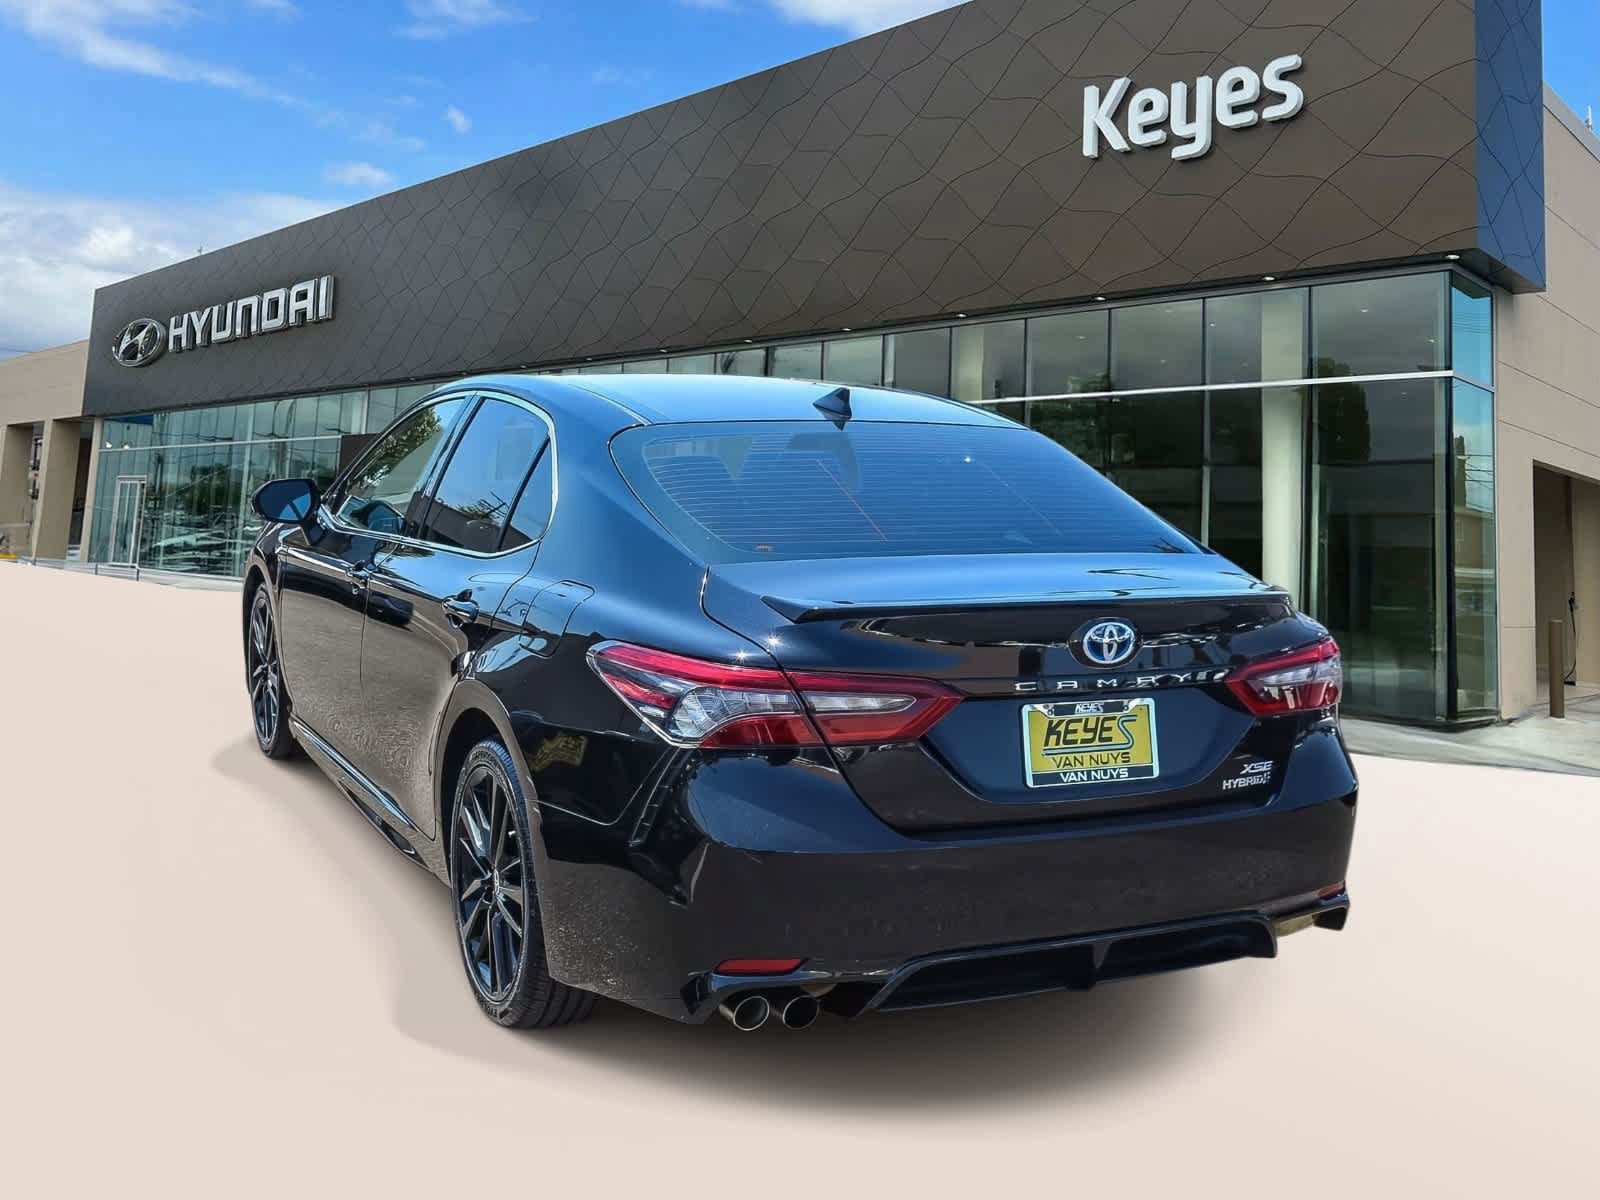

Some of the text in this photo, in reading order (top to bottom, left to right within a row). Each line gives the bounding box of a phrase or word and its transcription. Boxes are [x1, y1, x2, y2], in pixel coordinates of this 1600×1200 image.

[1082, 53, 1304, 161] Keyes
[167, 274, 335, 353] HYUNDAI
[1015, 672, 1192, 691] CAMRY
[1075, 702, 1104, 714] KEYES
[1043, 714, 1138, 748] KEYES
[1053, 751, 1131, 769] VAN NUYS
[1239, 760, 1274, 775] XSE
[1060, 767, 1129, 783] VAN NUYS
[1222, 773, 1266, 790] HYBRID
